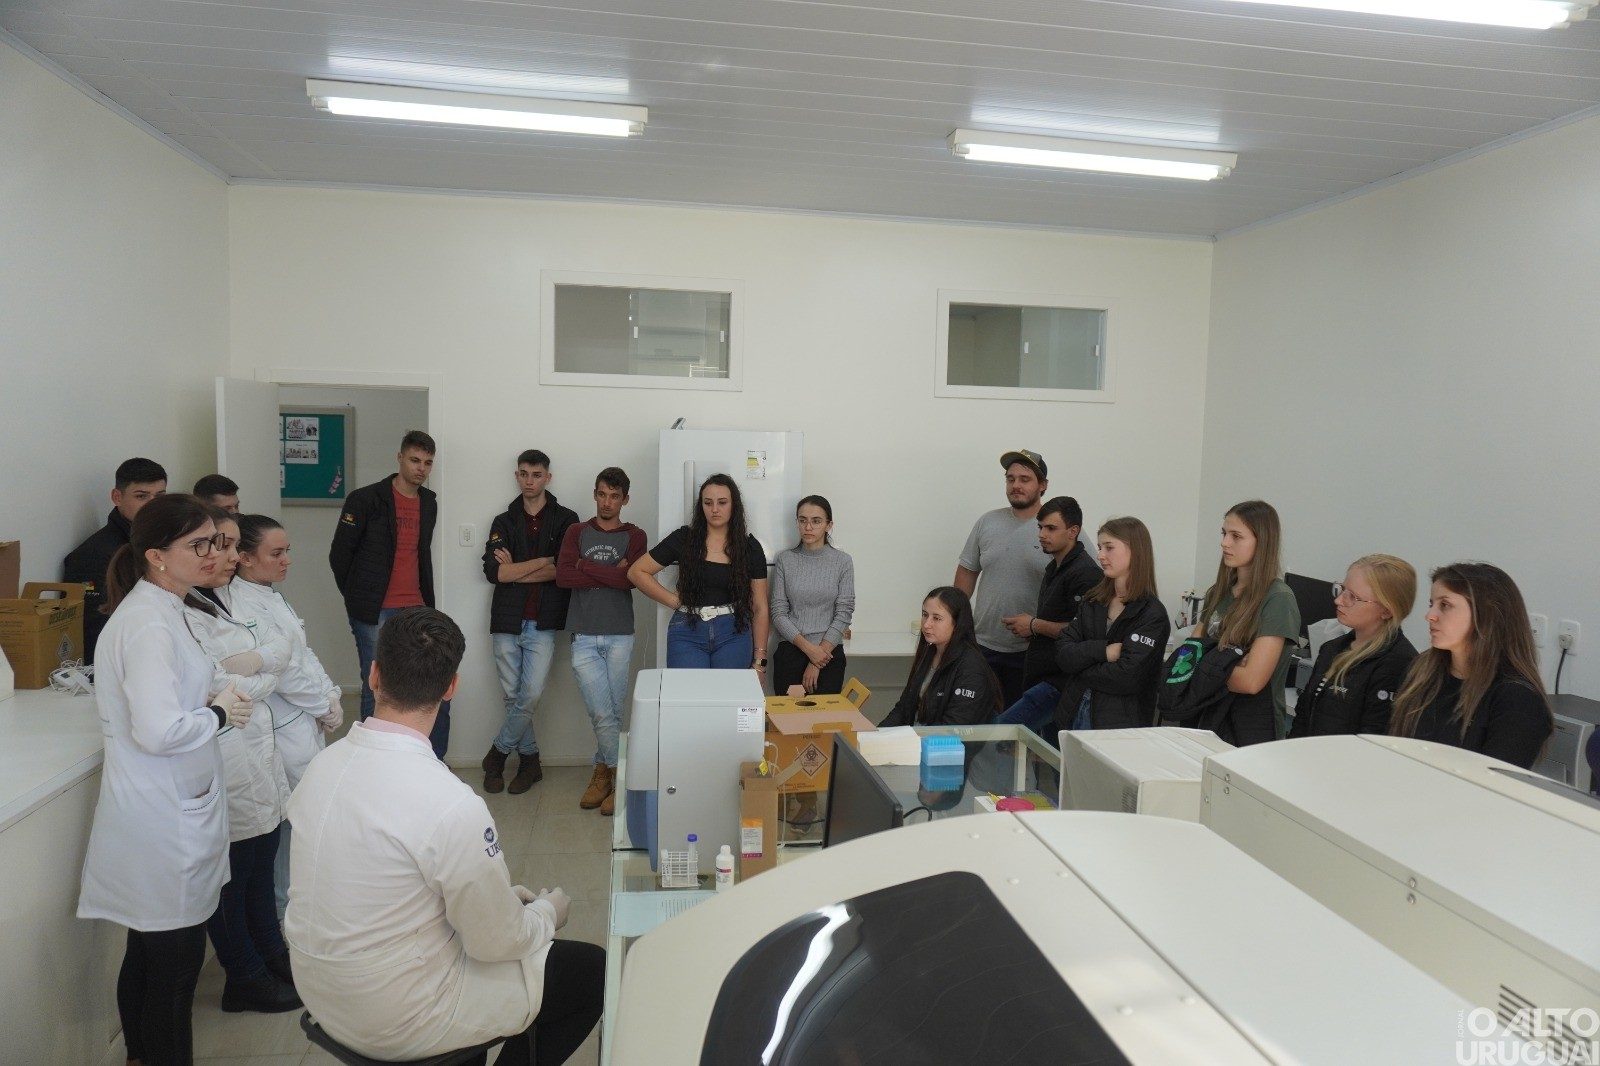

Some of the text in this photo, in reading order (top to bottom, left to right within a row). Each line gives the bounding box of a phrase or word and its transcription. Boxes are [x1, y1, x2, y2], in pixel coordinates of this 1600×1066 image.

[1140, 635, 1156, 647] URI
[961, 689, 976, 699] URI
[484, 842, 502, 858] UR
